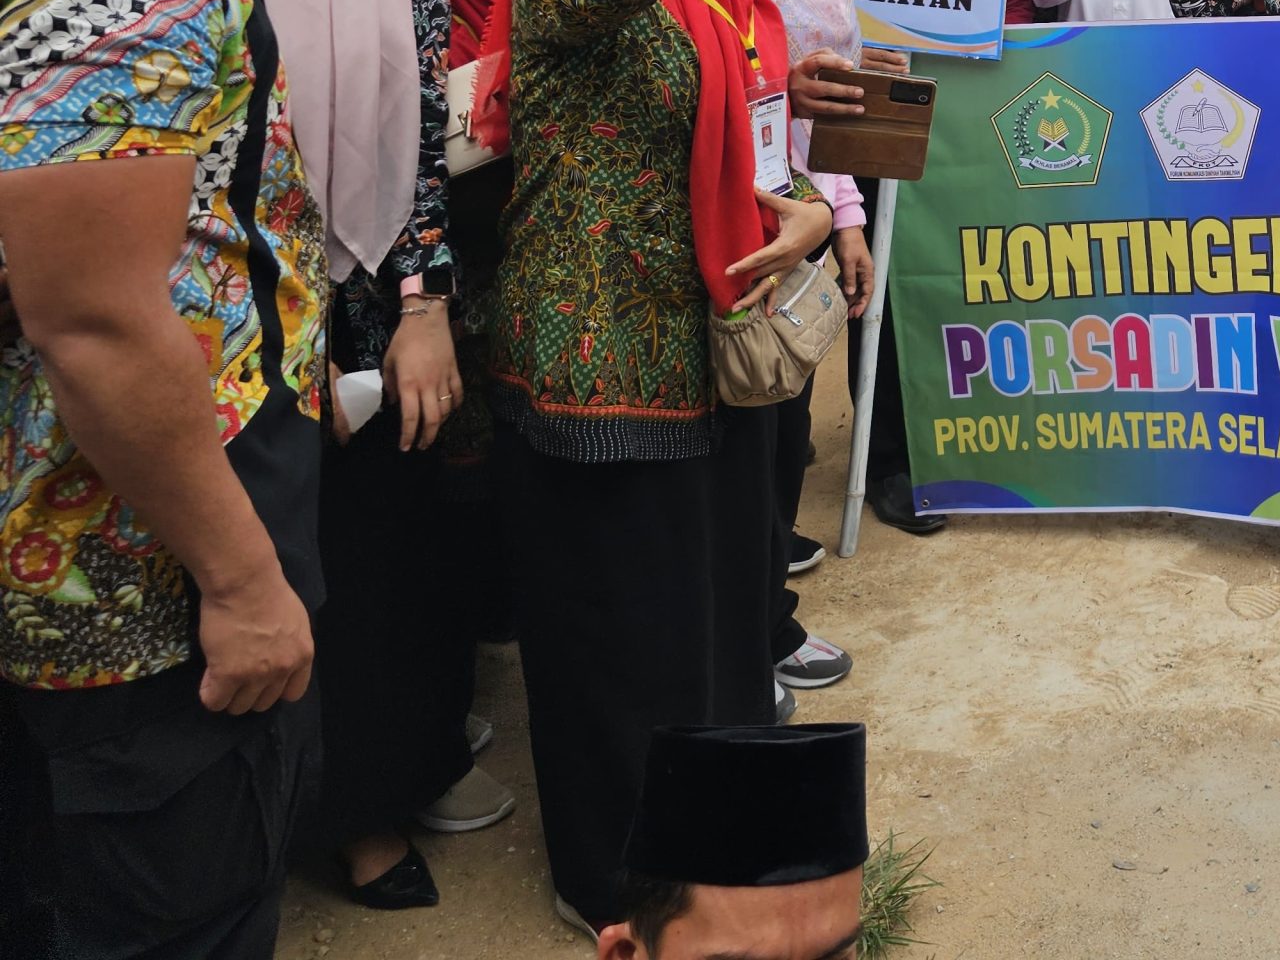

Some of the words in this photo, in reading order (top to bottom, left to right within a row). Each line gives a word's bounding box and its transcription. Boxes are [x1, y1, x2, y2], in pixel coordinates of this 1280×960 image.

[942, 312, 1259, 399] PORSADIN
[934, 415, 1029, 456] PROV.
[1037, 412, 1211, 451] SUMATERA
